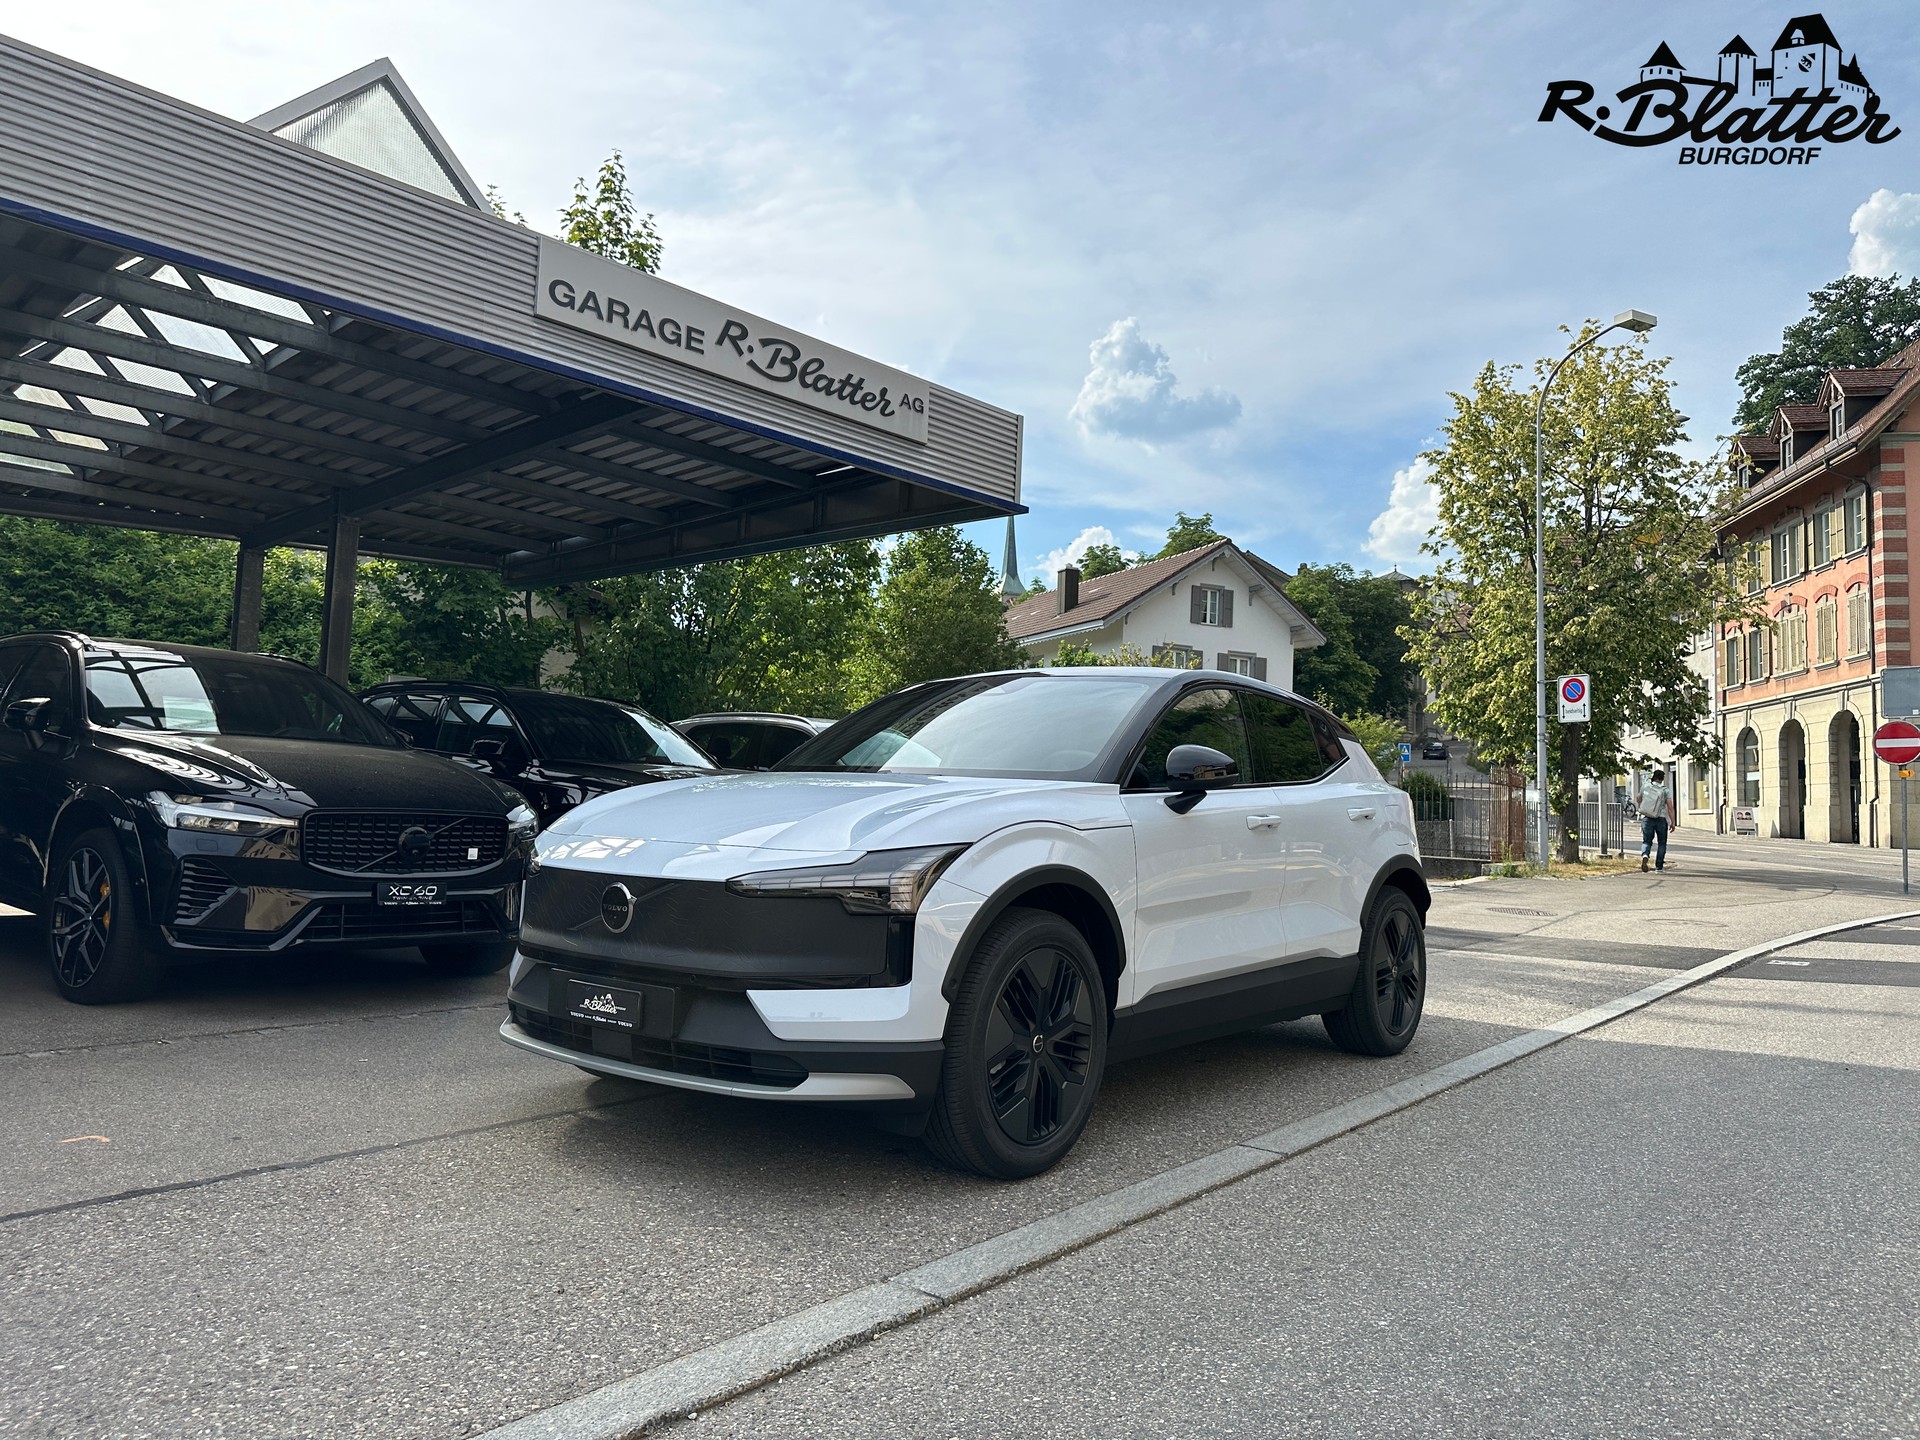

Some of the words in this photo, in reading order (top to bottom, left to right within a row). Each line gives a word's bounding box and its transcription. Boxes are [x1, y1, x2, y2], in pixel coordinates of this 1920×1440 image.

[548, 278, 705, 355] GARAGE
[899, 393, 925, 414] AG
[603, 903, 628, 912] VOLVO
